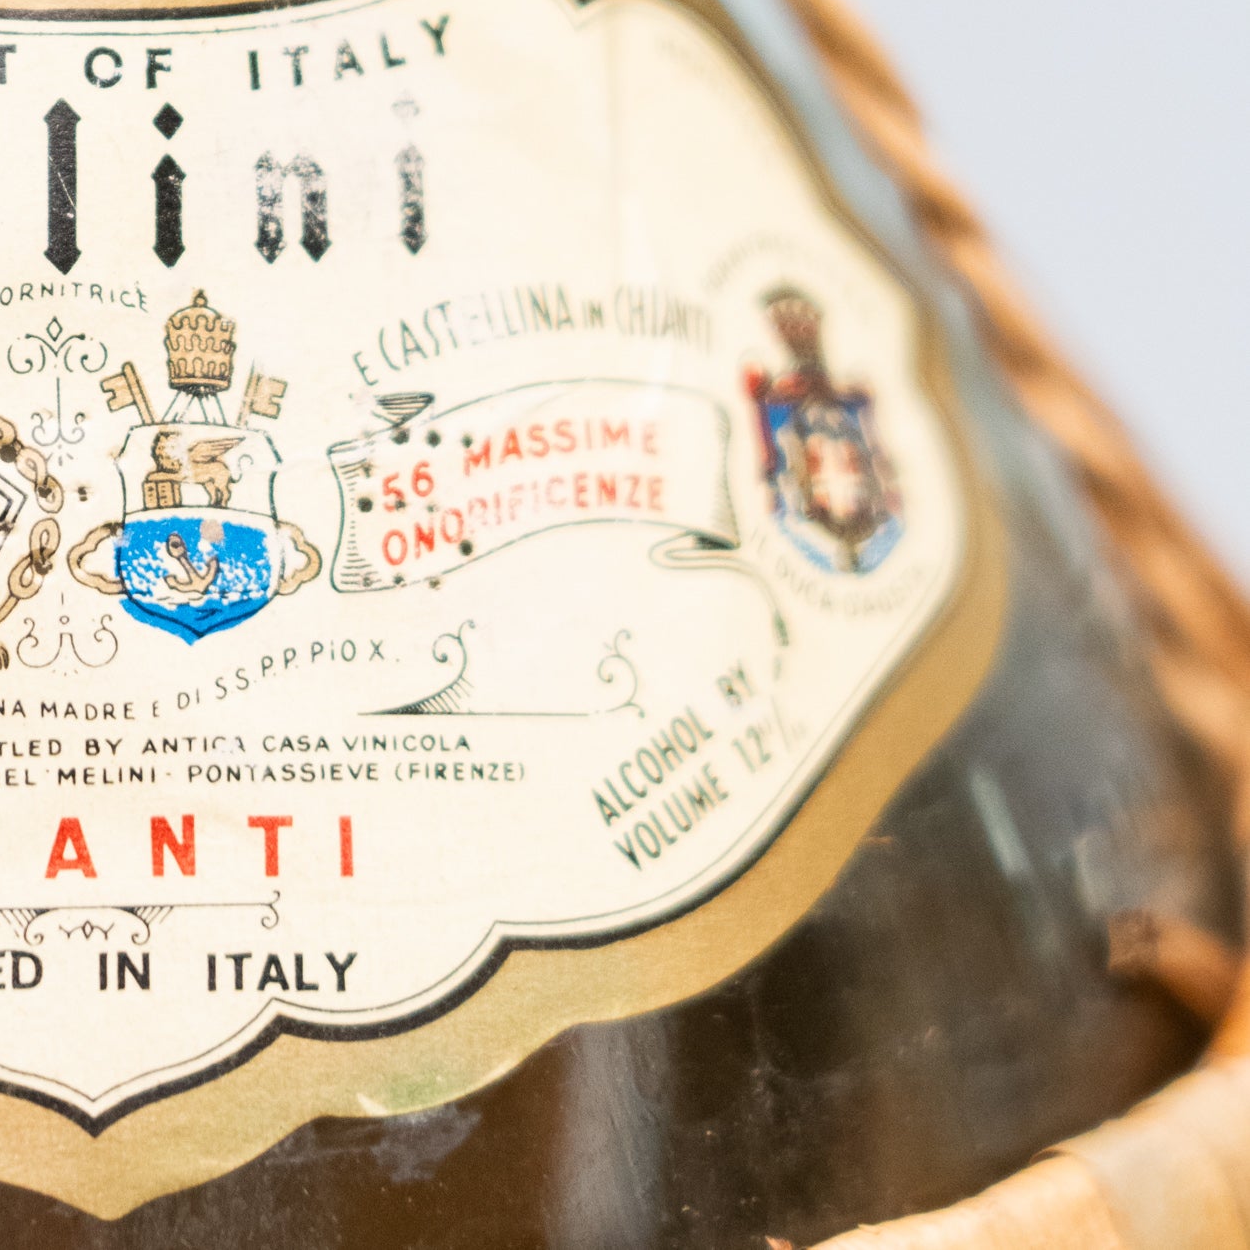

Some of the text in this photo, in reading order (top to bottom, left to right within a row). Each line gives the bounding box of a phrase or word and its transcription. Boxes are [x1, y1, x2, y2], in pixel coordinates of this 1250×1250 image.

[83, 46, 173, 90] OF
[247, 15, 450, 91] ITALY
[382, 418, 660, 512] 56 MASSIME
[381, 470, 665, 566] ONORIFICENZE
[40, 700, 136, 721] MADRE
[152, 700, 161, 718] E
[176, 687, 201, 711] DI
[57, 766, 156, 786] MELINI
[188, 762, 380, 785] PONTASSIEVE
[394, 761, 527, 783] (FIRENZE)
[84, 737, 123, 757] BY
[262, 734, 331, 752] CASA
[342, 733, 472, 753] VINICOLA
[591, 704, 714, 828] ALCOHOL
[612, 761, 730, 872] VOLUME
[98, 951, 151, 992] IN
[206, 951, 358, 993] ITALY
